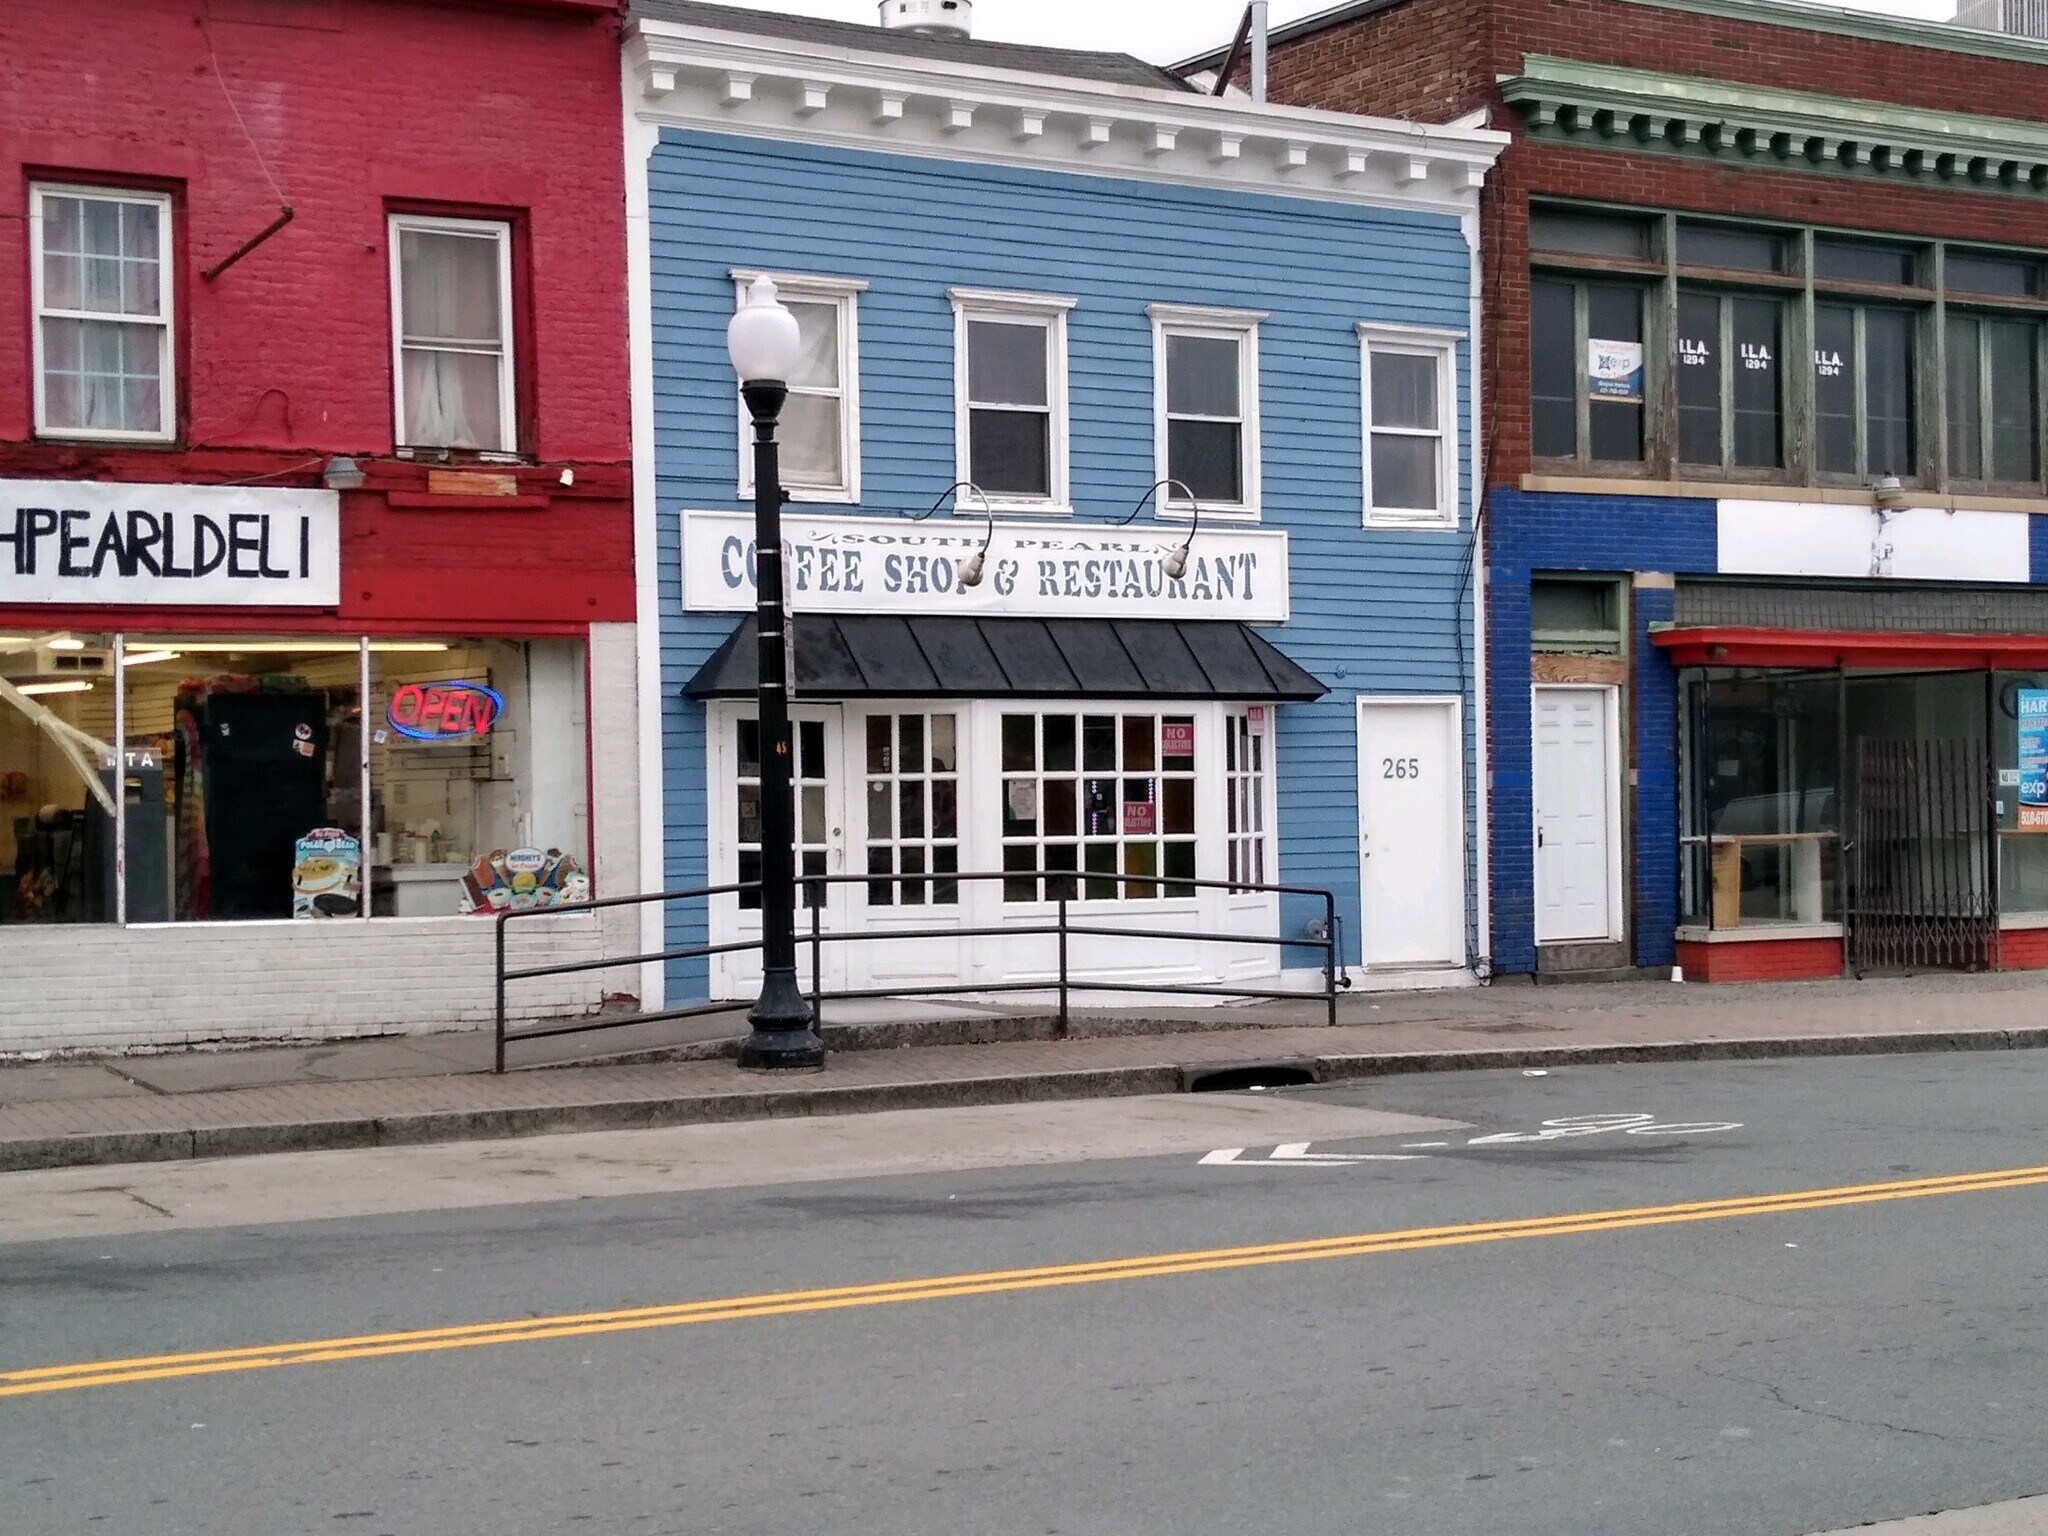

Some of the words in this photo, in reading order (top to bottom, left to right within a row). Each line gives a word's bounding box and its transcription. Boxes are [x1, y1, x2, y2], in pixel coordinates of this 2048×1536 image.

[1683, 354, 1705, 365] 1294
[1745, 359, 1767, 370] 1294
[1818, 366, 1840, 376] 1294
[841, 534, 988, 548] SOUTH
[1013, 539, 1149, 552] PEARL
[721, 535, 864, 593] CFEE
[993, 558, 1019, 596] &
[391, 684, 493, 735] OPEN
[1166, 727, 1186, 739] NO
[1382, 757, 1419, 779] 265
[2020, 780, 2046, 798] exp
[1127, 805, 1147, 817] NO
